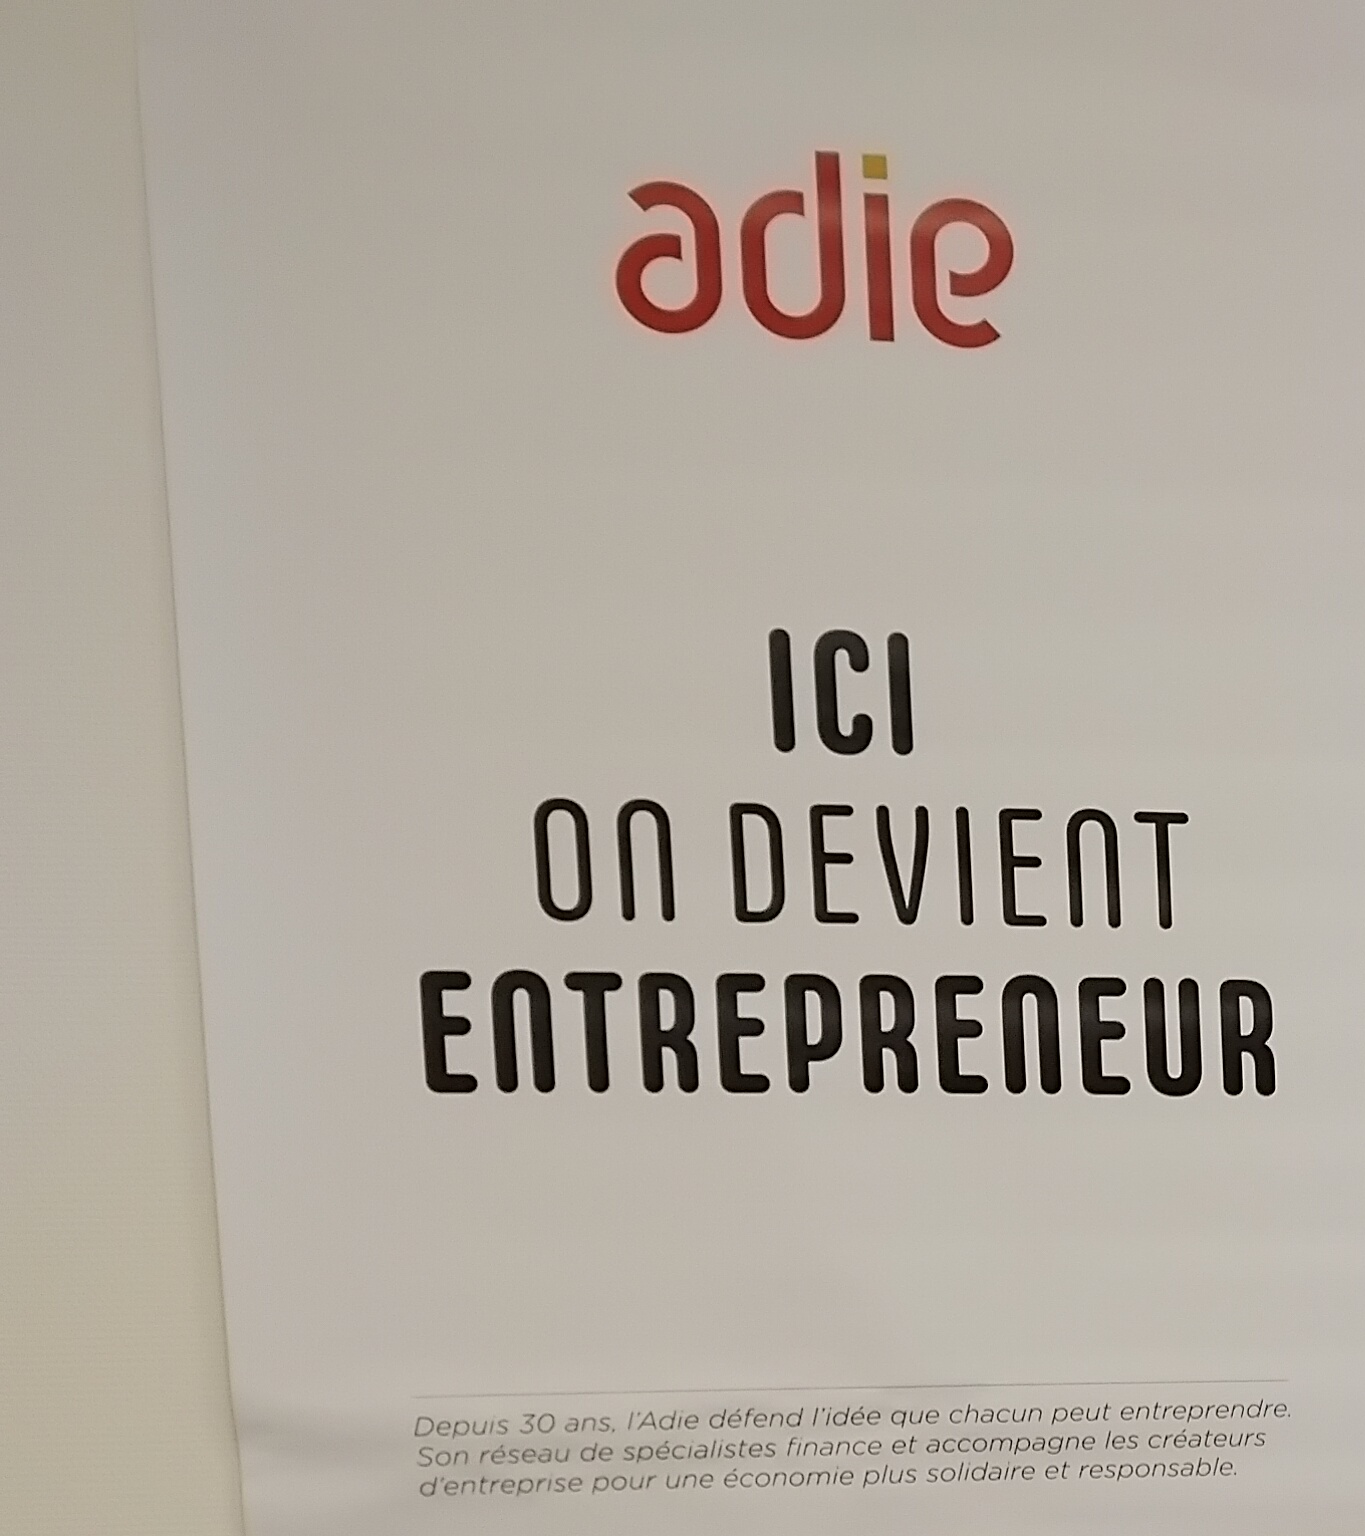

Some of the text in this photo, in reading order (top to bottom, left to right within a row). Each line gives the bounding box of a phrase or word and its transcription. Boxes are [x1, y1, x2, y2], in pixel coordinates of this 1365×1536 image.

[615, 151, 1013, 348] adie
[768, 628, 914, 755] ICI
[534, 797, 1189, 929] ON DEVIENT
[419, 968, 1276, 1097] ENTREPRENEUR
[413, 1399, 1292, 1441] Depuis 30 ans, l'Adie défend l'idée que chacun peut entreprendre.
[417, 1428, 1267, 1467] Son réseau de spécialistes finance et accompagne les créateurs
[419, 1456, 1238, 1498] d'entreprise pour une économie plus solidaire et responsable.
